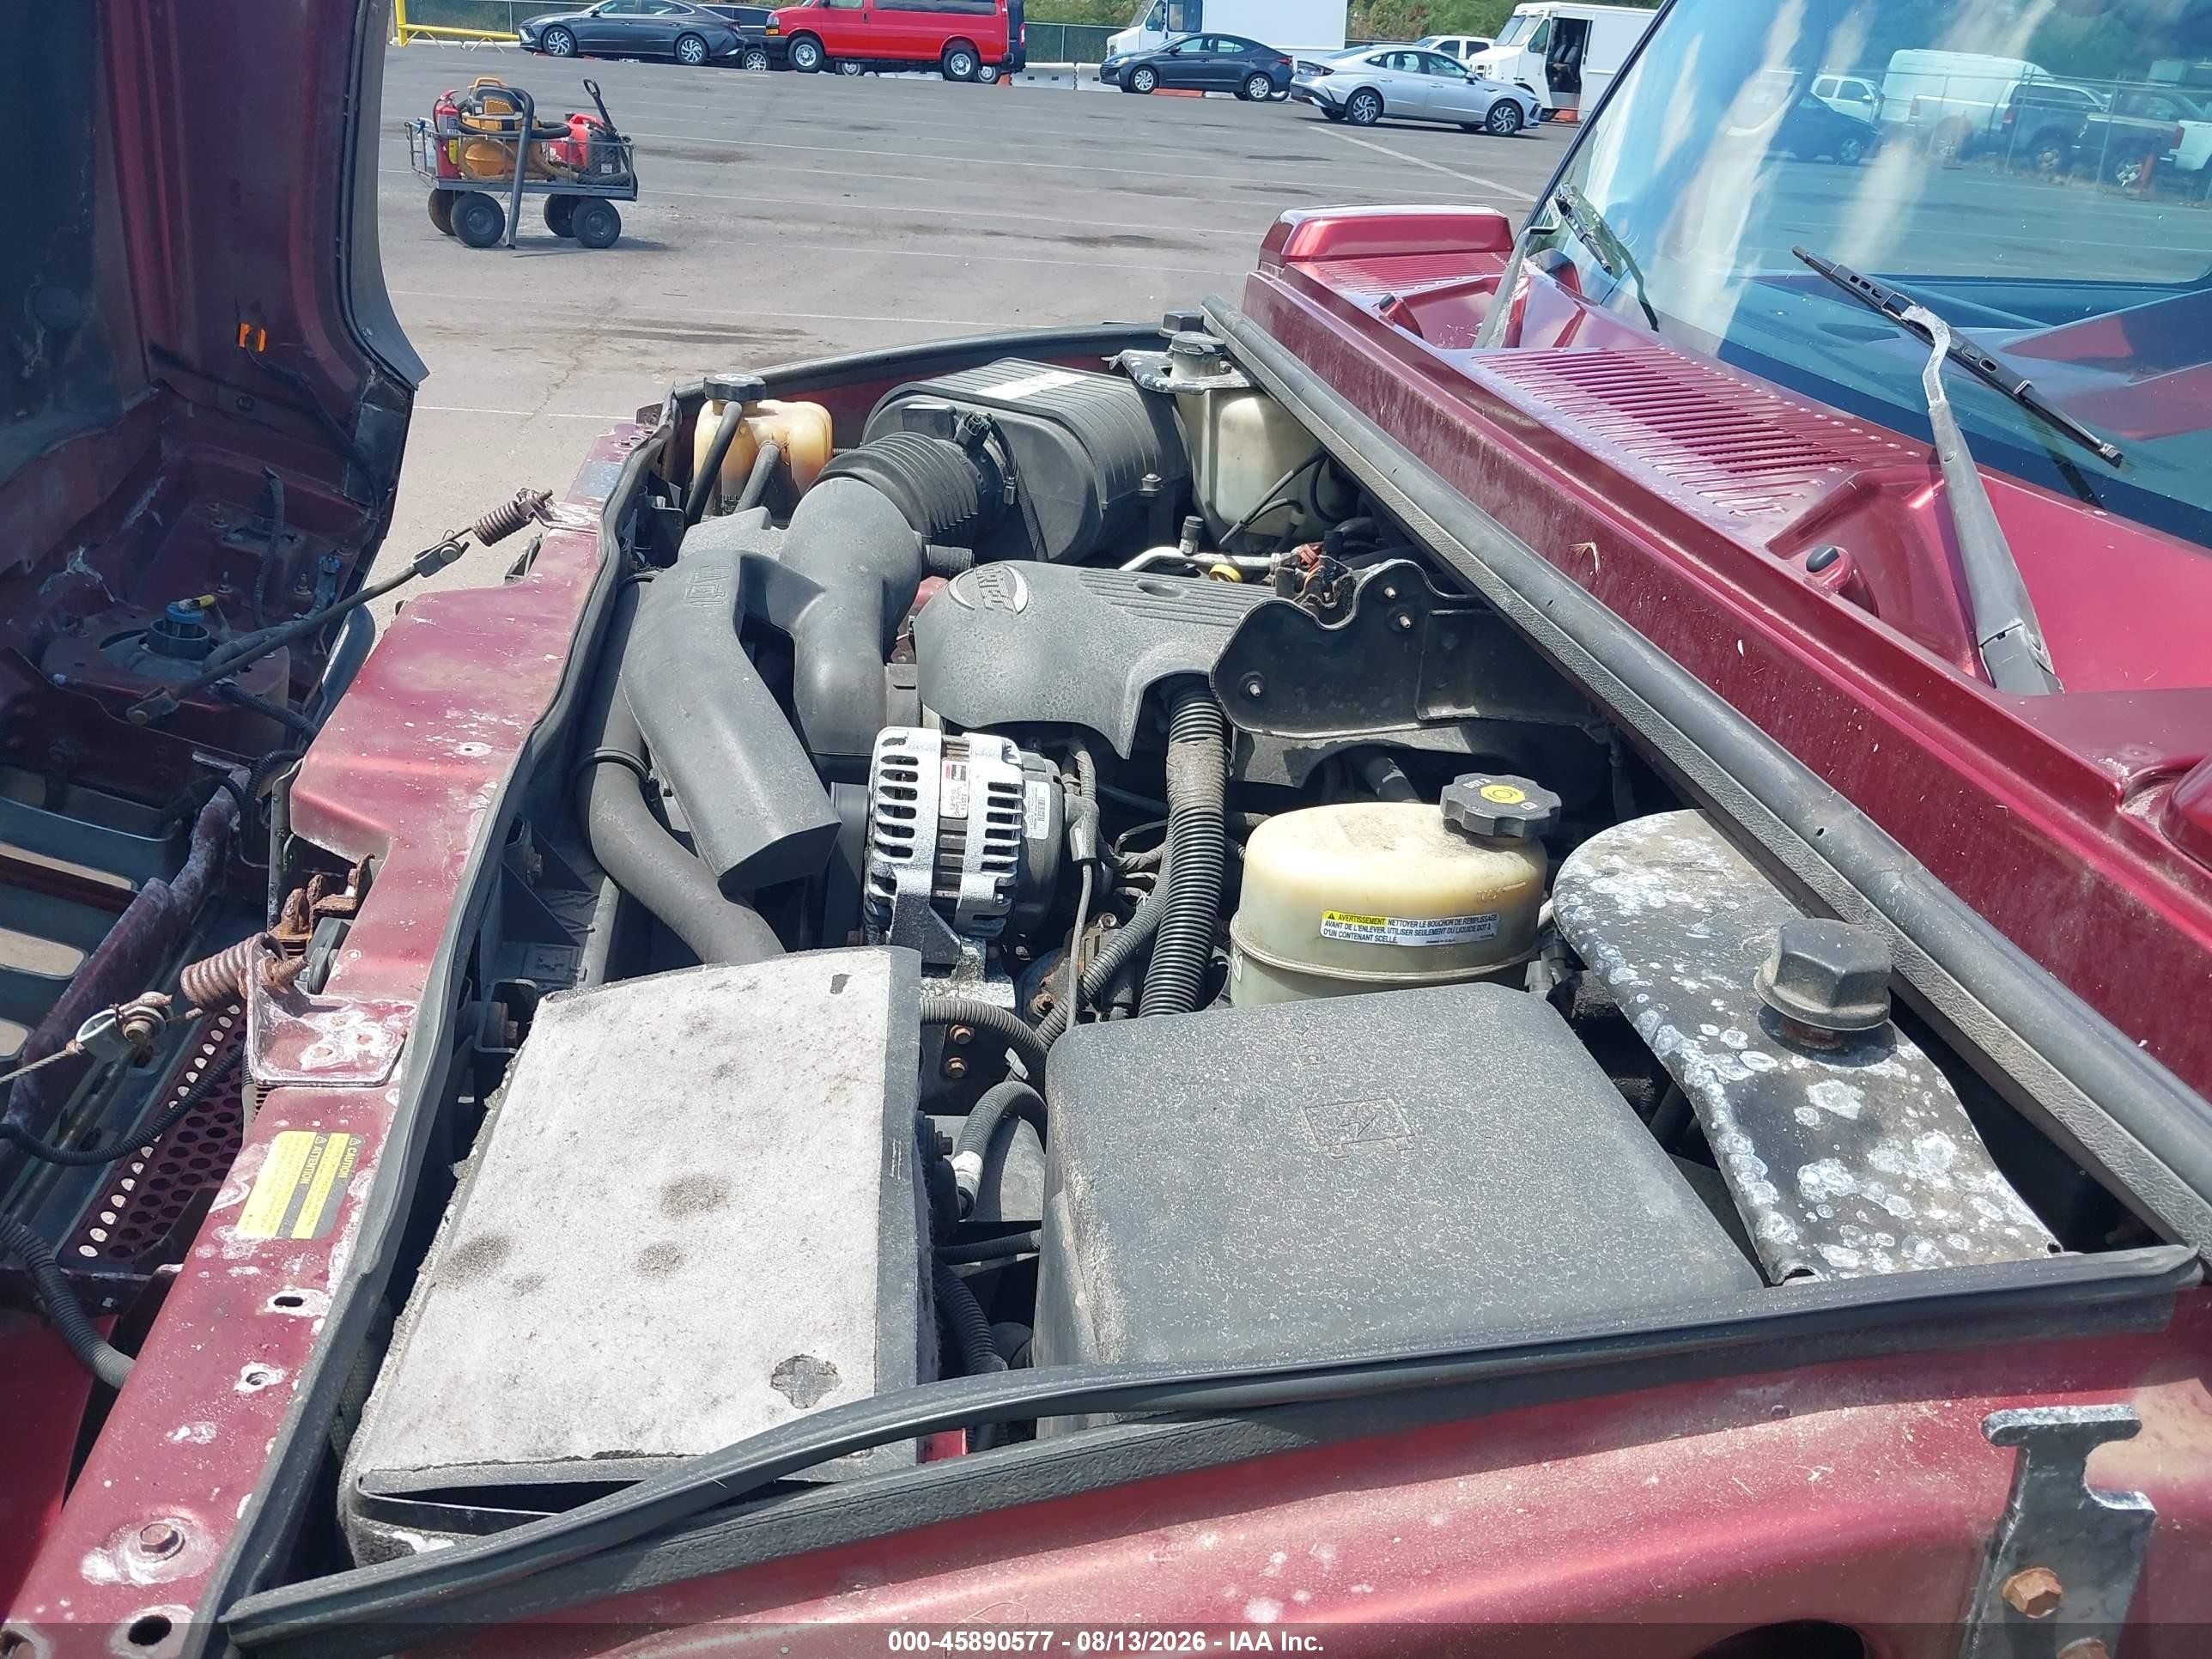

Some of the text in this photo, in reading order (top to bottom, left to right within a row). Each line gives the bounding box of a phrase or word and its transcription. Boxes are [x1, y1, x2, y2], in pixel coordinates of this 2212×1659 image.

[1324, 920, 1343, 929] AVANT
[1345, 923, 1353, 932] DE
[1387, 927, 1413, 936] UTILISER
[1413, 927, 1446, 936] SEULEMENT
[1338, 913, 1387, 926] AVERTISSEMENT
[1388, 919, 1419, 928] NETTOYER
[1427, 919, 1454, 927] BOUCHON
[1462, 913, 1498, 925] REMPLISSAGE
[1338, 931, 1374, 942] CONTENANT
[299, 1146, 323, 1185] ATTENTION
[338, 1147, 357, 1179] CAUTION
